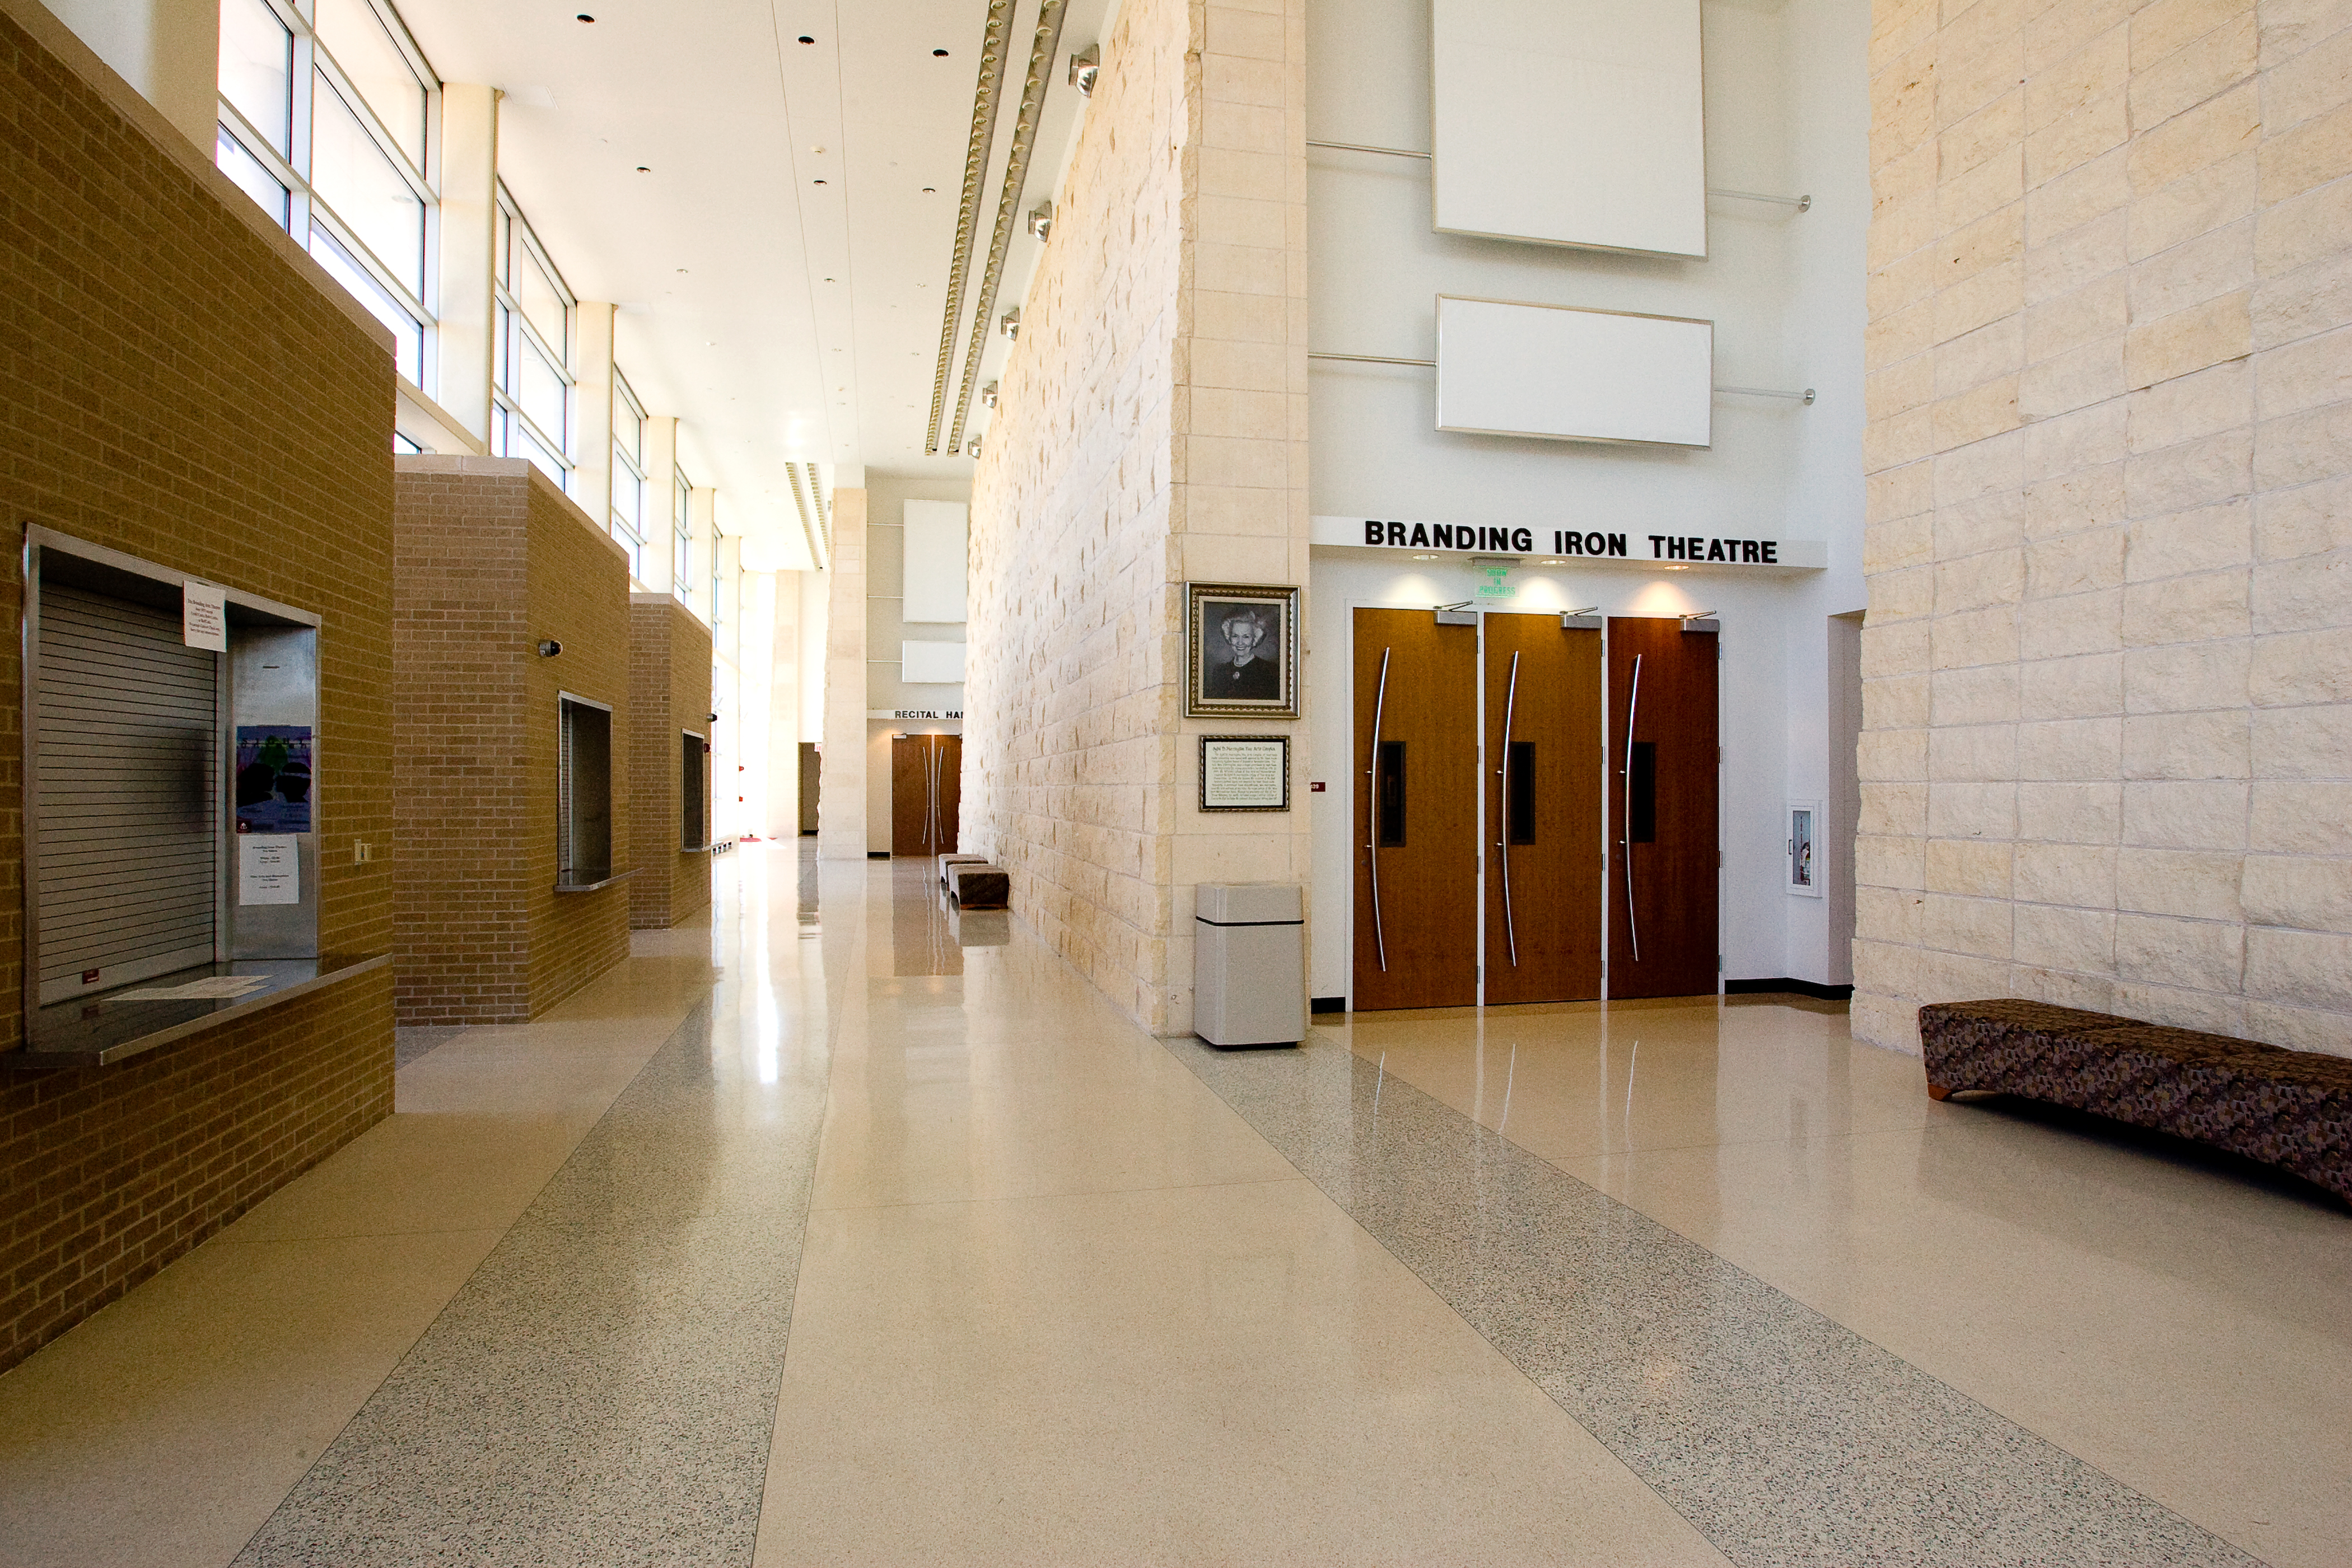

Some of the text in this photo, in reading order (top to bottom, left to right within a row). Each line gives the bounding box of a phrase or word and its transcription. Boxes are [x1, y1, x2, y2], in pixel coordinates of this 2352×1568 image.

[1365, 520, 1778, 564] BRANDING IRON THEATRE
[1479, 586, 1515, 595] PROGRESS
